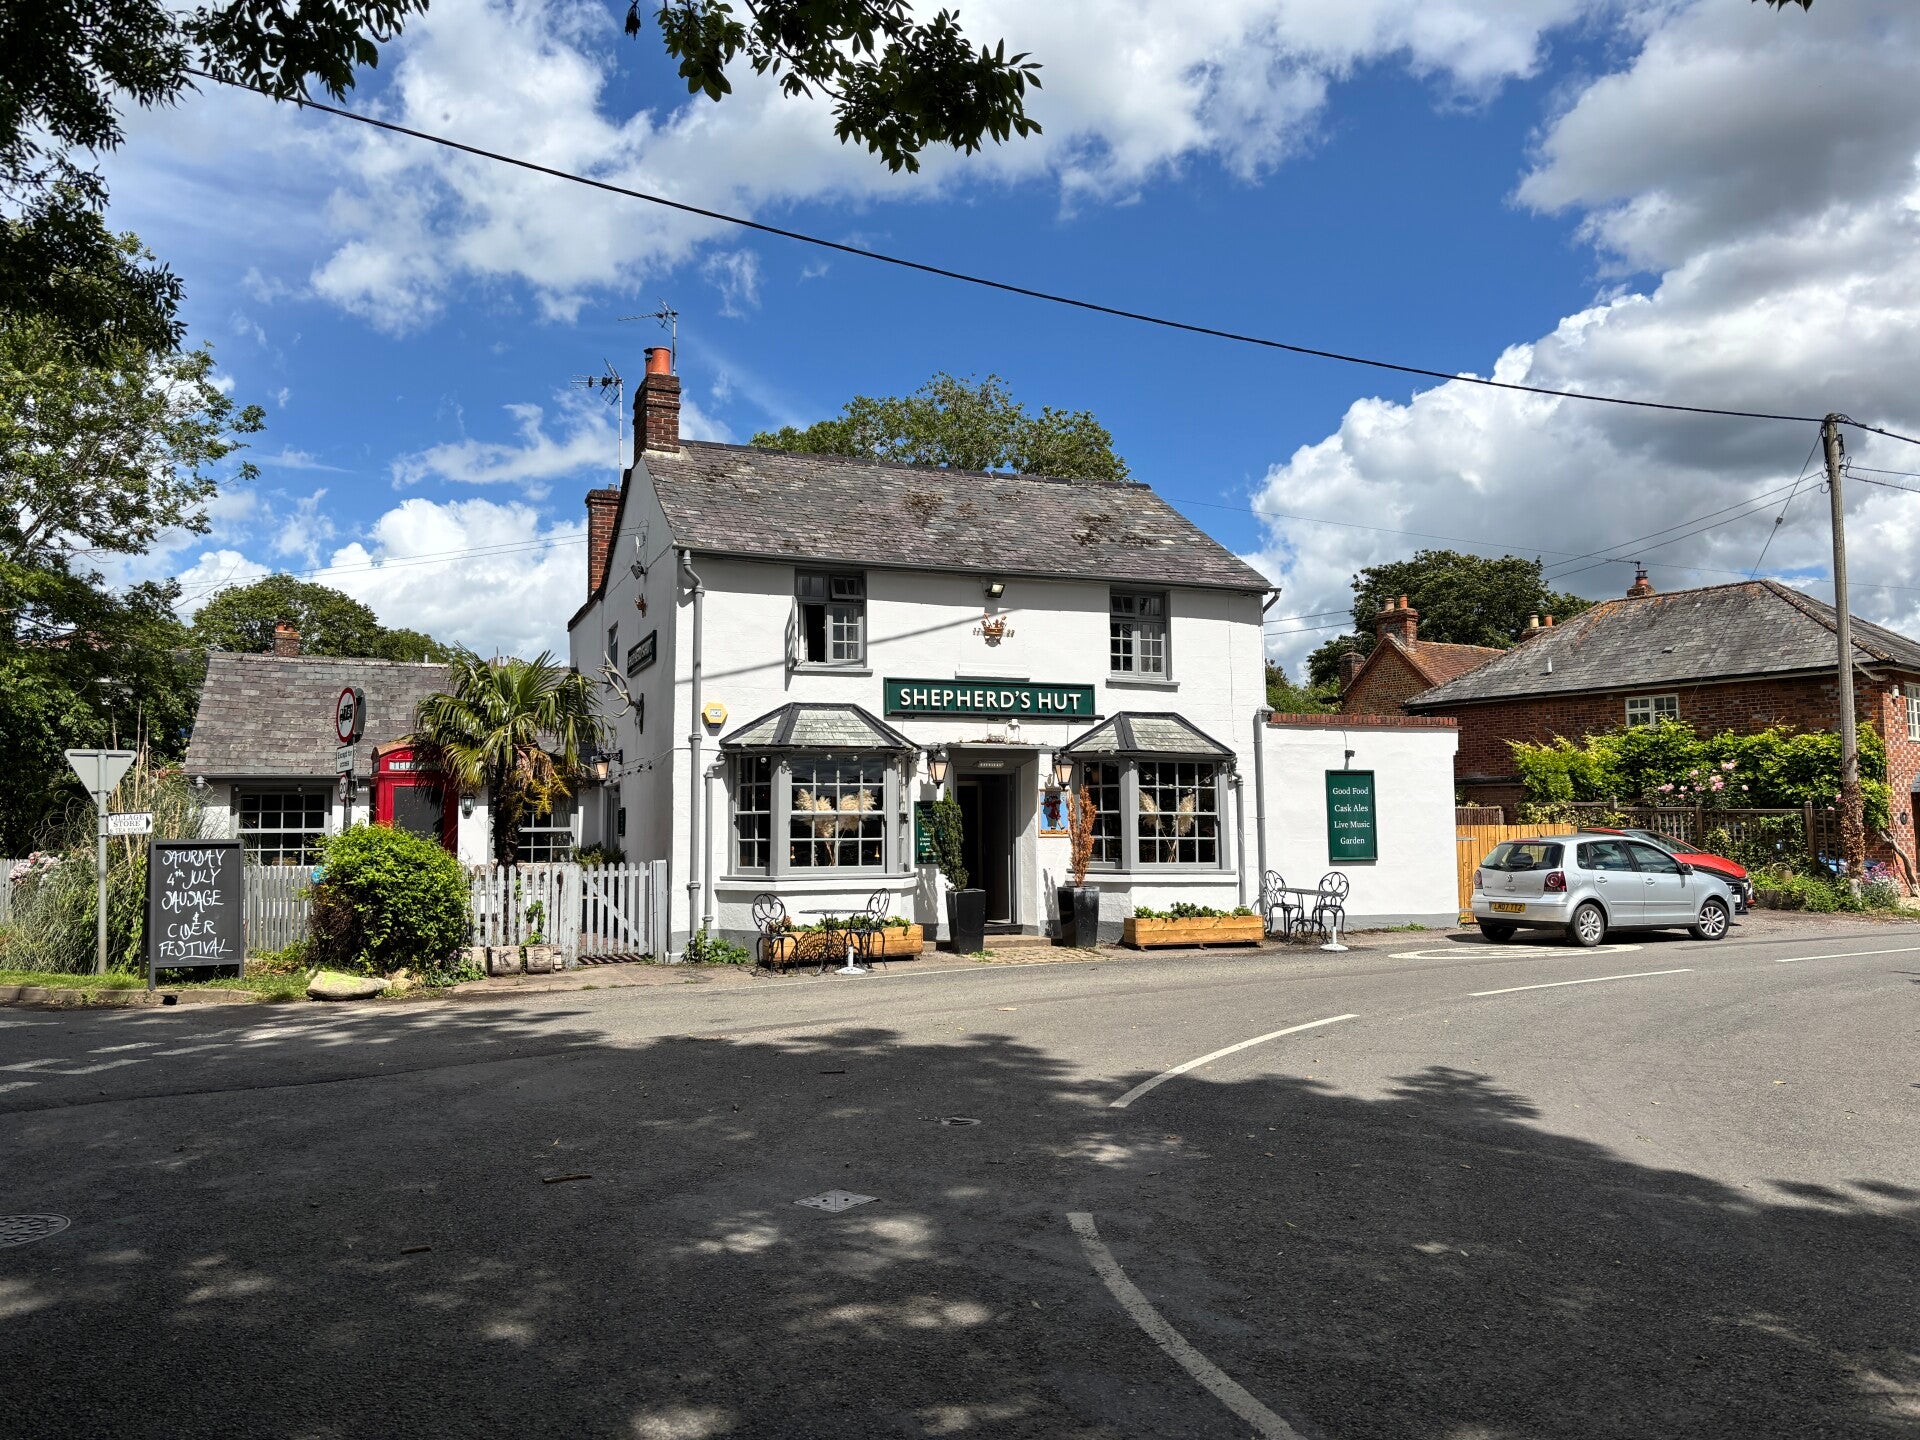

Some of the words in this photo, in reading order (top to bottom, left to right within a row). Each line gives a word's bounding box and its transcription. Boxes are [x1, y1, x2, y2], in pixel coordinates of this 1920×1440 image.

[900, 688, 1031, 709] SHEPHERD'S
[1038, 692, 1082, 710] HUT
[1332, 787, 1351, 795] Good
[1352, 787, 1369, 795] Food
[1334, 803, 1352, 812] Cask
[1353, 803, 1369, 812] Ales
[113, 820, 141, 828] STORE
[1334, 820, 1349, 829] Live
[1350, 820, 1370, 828] Music
[1340, 836, 1365, 845] Garden
[162, 849, 227, 869] SATURDAY
[166, 869, 186, 886] 4th
[182, 868, 222, 889] JULY
[161, 890, 225, 914] SAUSAGE
[167, 920, 217, 940] CIDER
[158, 937, 234, 958] FESTIVAL
